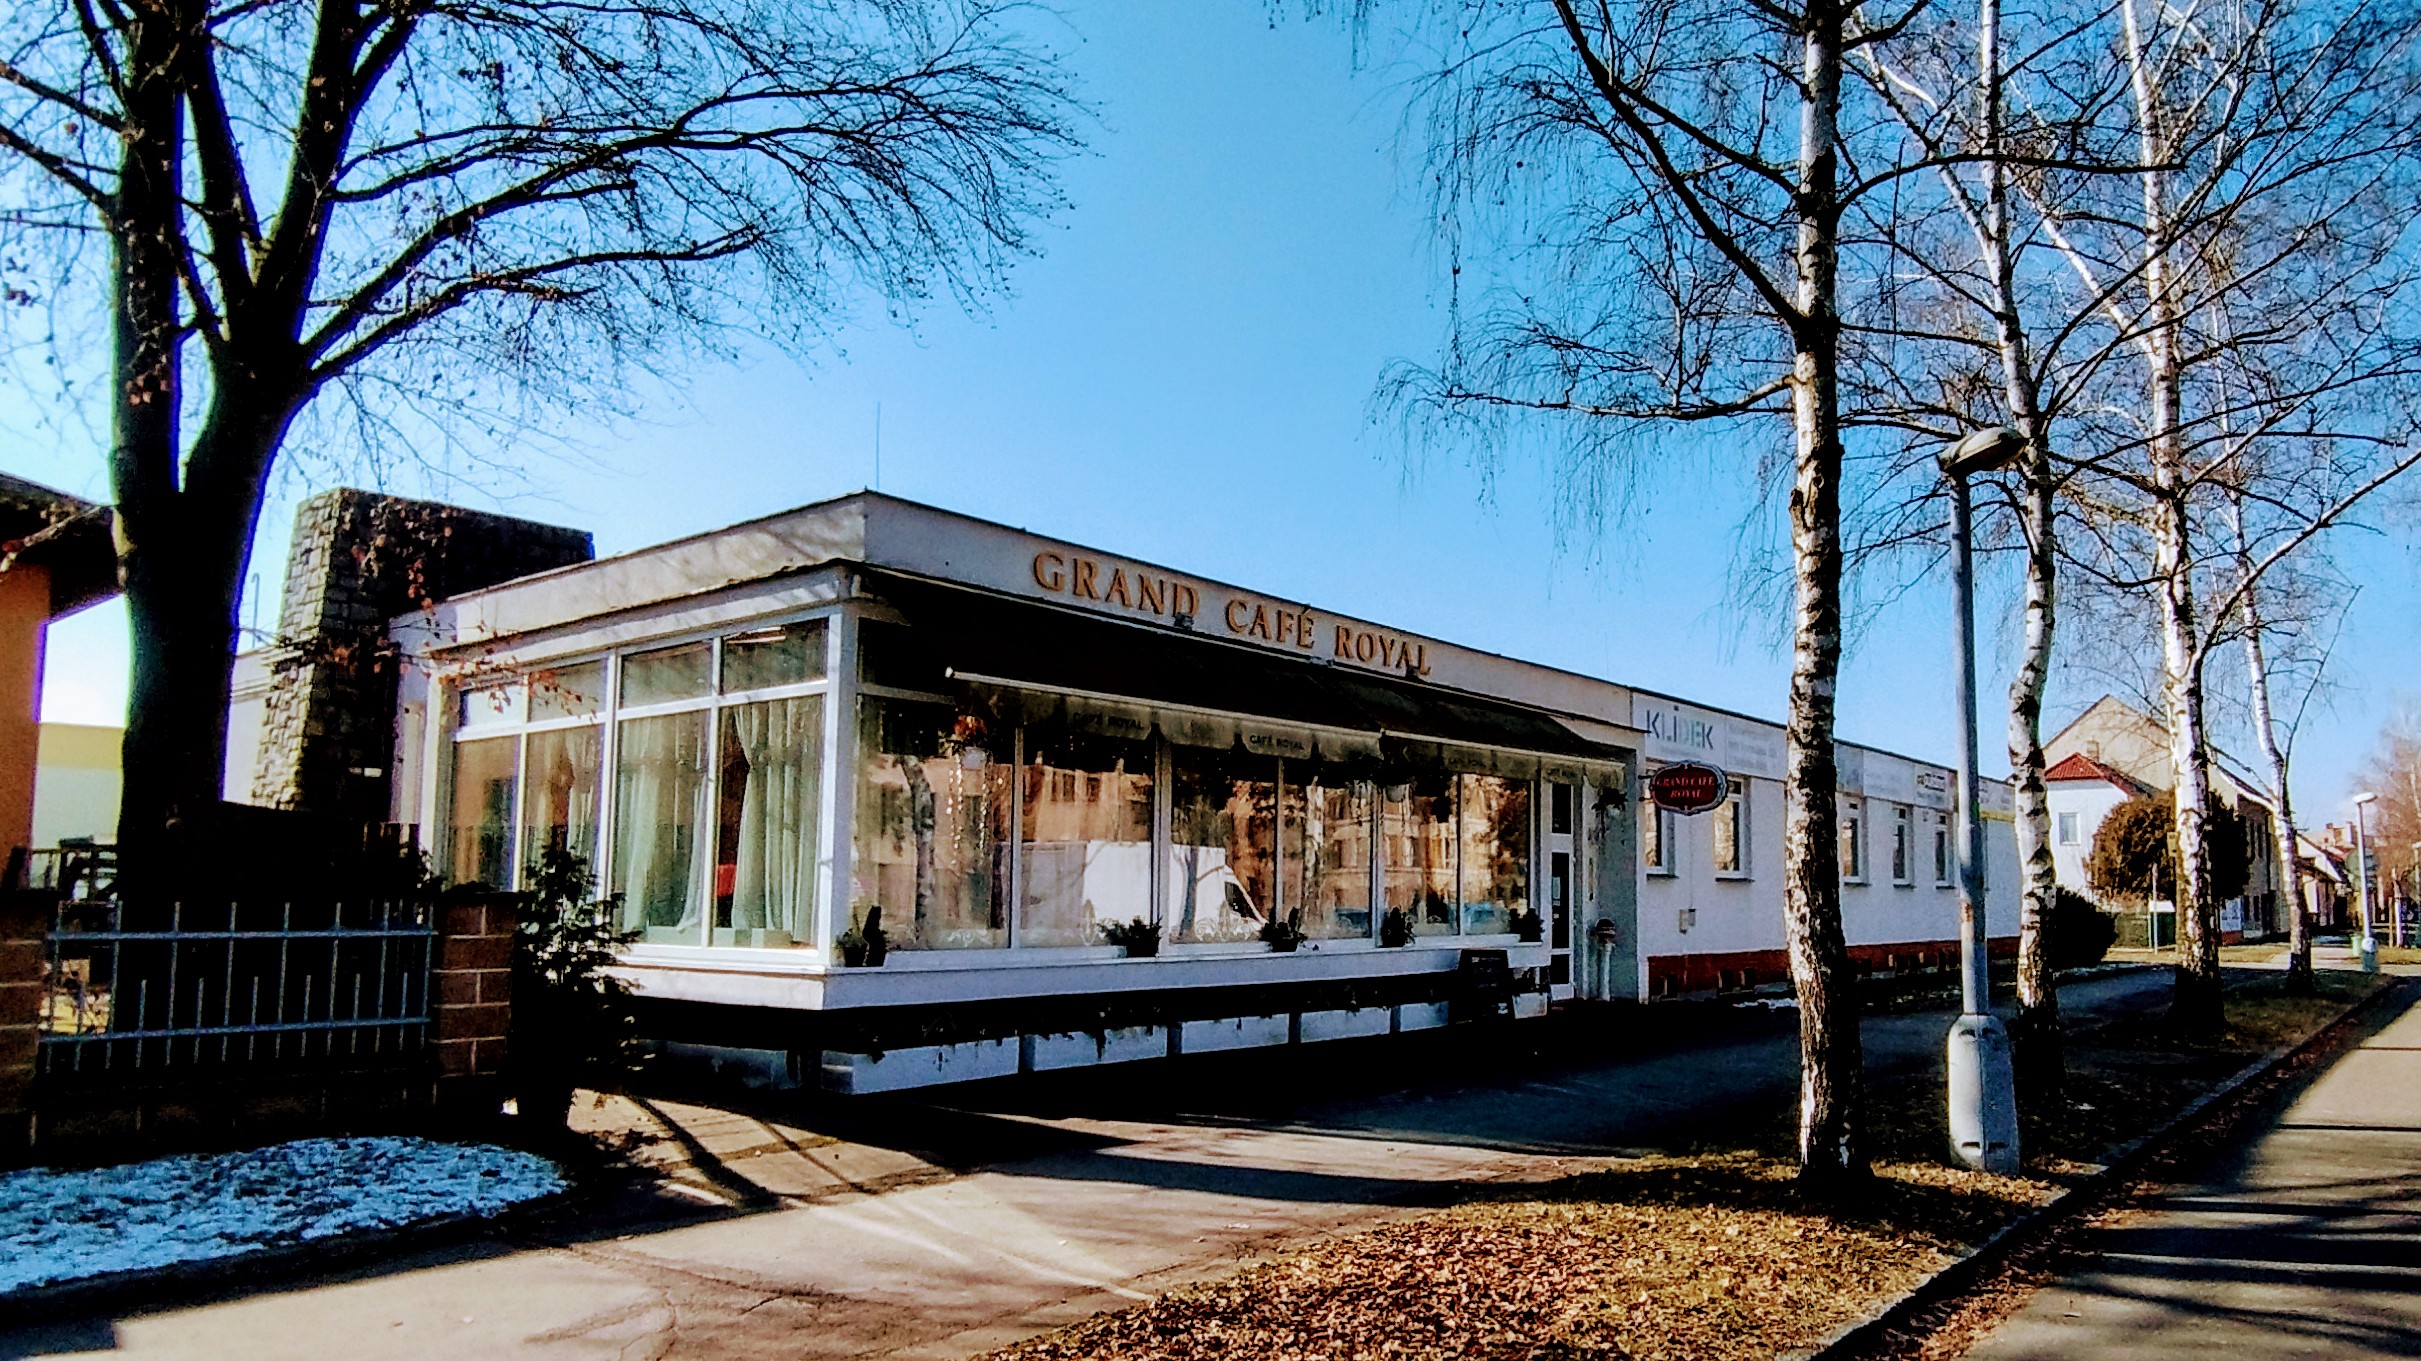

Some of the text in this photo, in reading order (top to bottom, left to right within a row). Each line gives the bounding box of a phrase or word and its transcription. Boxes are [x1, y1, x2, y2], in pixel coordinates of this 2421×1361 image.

[1033, 550, 1431, 676] GRAND CAFÉ ROYAL
